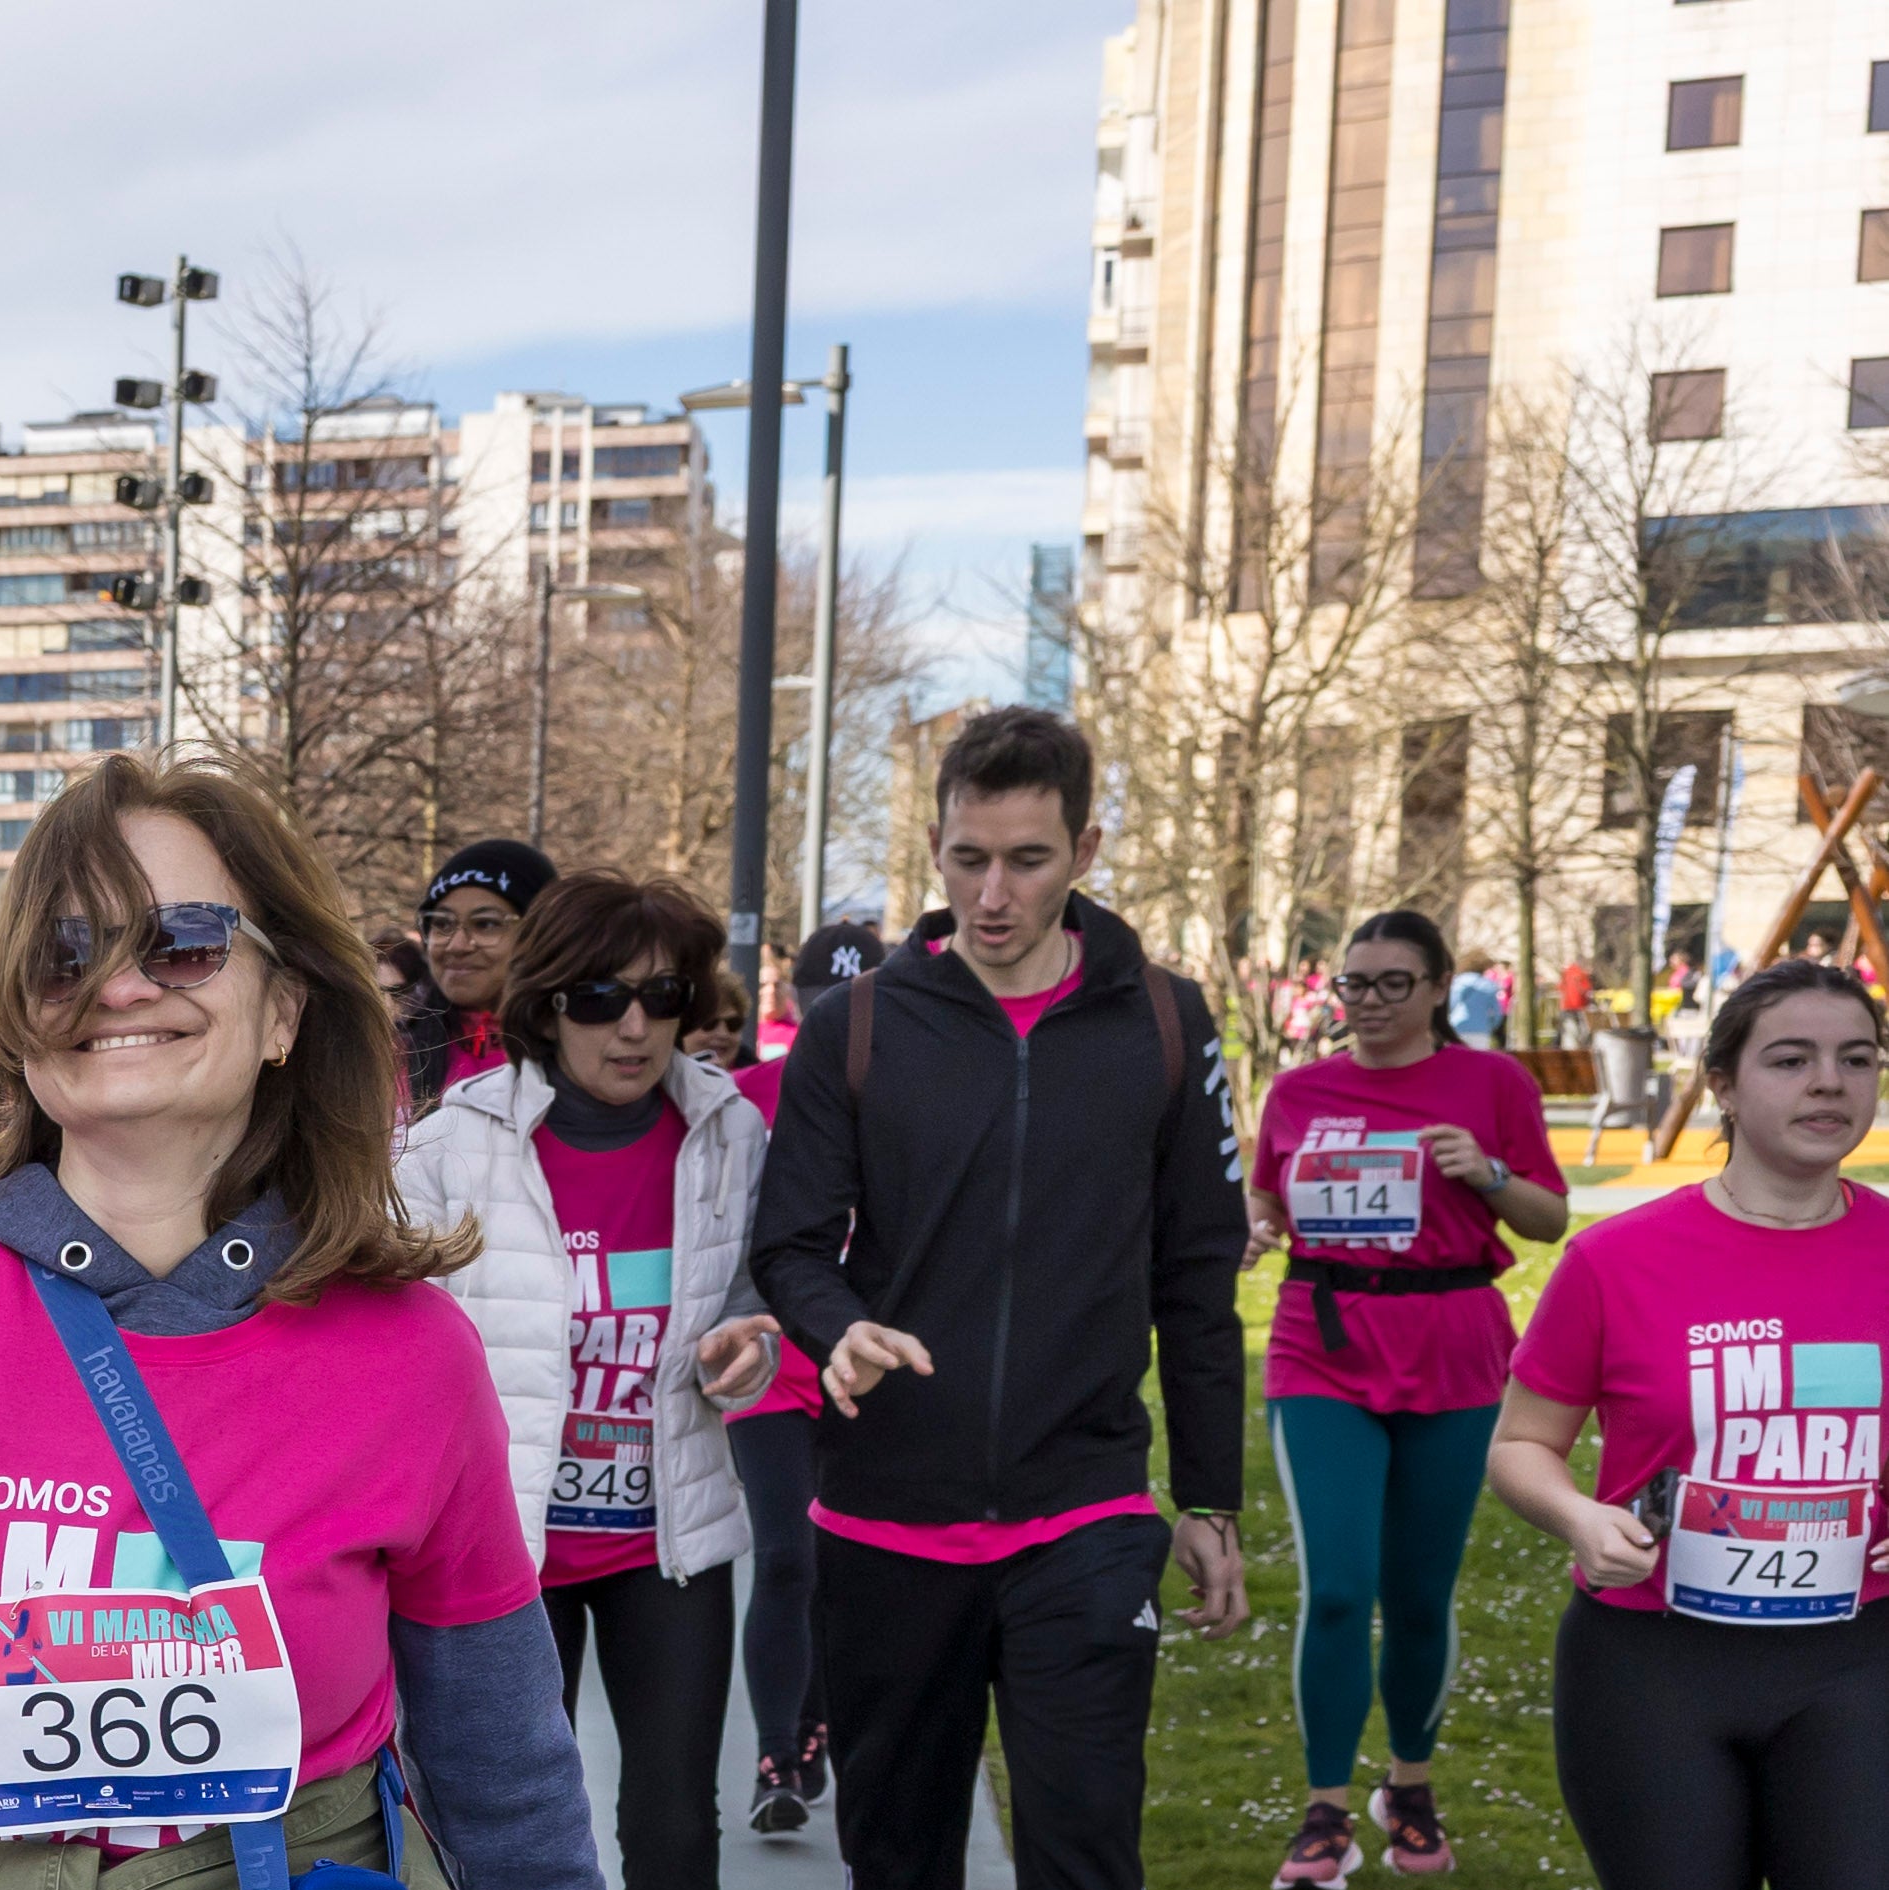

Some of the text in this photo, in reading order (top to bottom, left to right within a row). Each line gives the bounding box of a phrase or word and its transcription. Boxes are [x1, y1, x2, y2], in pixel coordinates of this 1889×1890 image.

[1320, 1184, 1389, 1215] 114
[1688, 1318, 1783, 1345] SOMOS
[83, 1346, 178, 1504] havaianas
[1718, 1414, 1880, 1481] PARA
[551, 1461, 653, 1506] 349
[1740, 1498, 1763, 1520] VI
[1787, 1520, 1848, 1542] MUJER
[1726, 1546, 1819, 1589] 742
[47, 1604, 239, 1646] VI MARCHA
[91, 1637, 246, 1680] DE LA MUJER
[21, 1683, 221, 1772] 366
